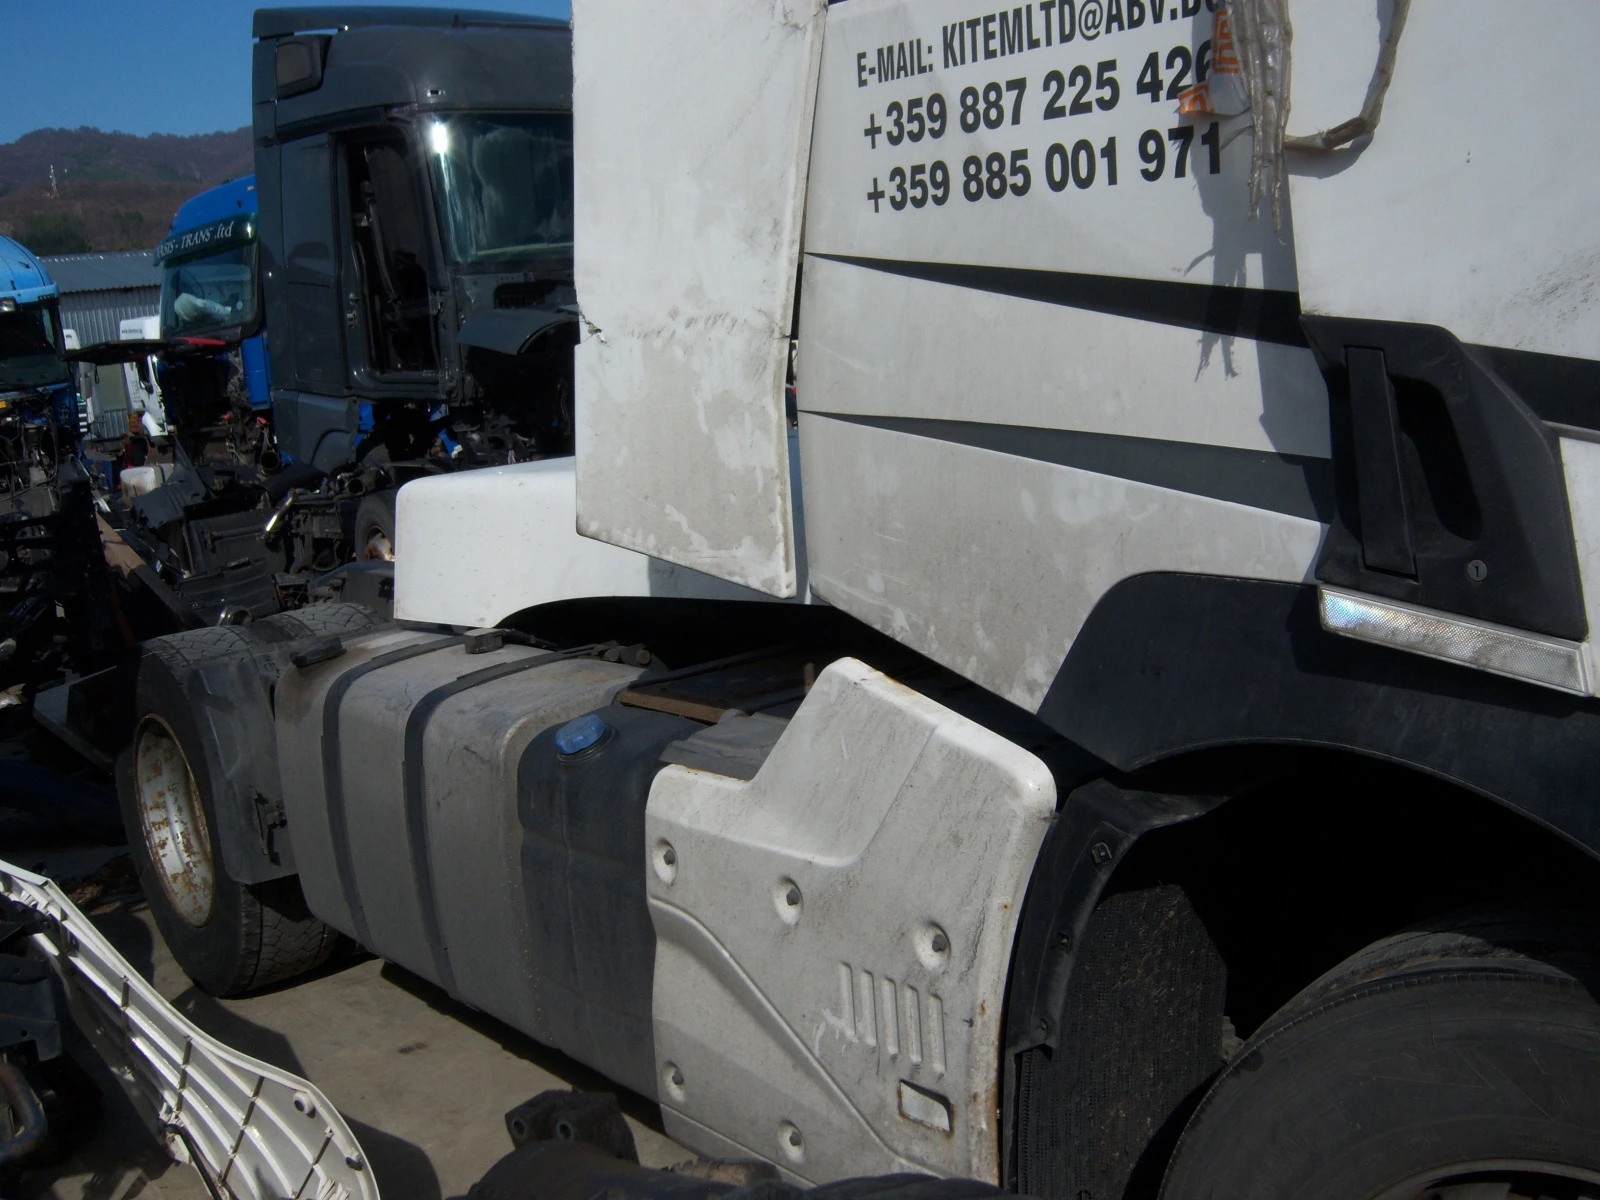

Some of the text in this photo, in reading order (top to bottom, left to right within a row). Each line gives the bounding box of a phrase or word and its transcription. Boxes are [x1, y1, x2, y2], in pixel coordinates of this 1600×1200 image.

[856, 38, 933, 88] E-MAIL:
[864, 92, 948, 149] +359
[959, 77, 1027, 134] 887
[1042, 59, 1120, 120] 225
[867, 121, 1221, 213] +359 885 001 971
